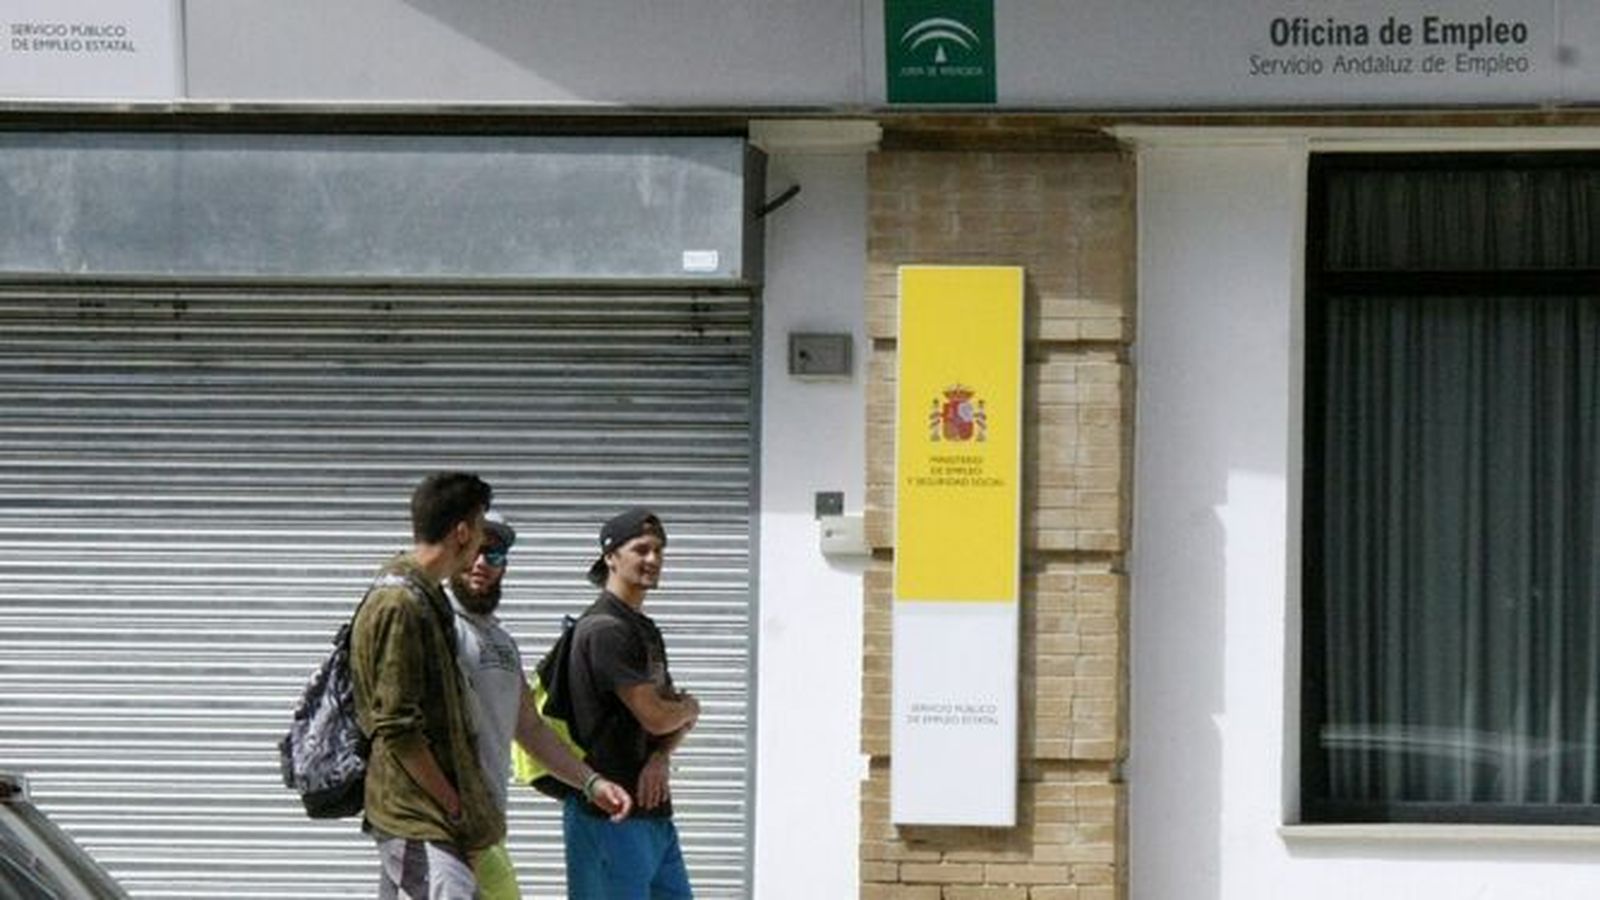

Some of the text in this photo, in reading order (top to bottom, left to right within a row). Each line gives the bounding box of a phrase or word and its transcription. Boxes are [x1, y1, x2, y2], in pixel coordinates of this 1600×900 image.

[1270, 16, 1528, 50] Oficina de Empleo
[11, 38, 135, 53] DE EMPLEO ESTATAL
[1249, 53, 1529, 77] Servicio Andaluz de Empleo
